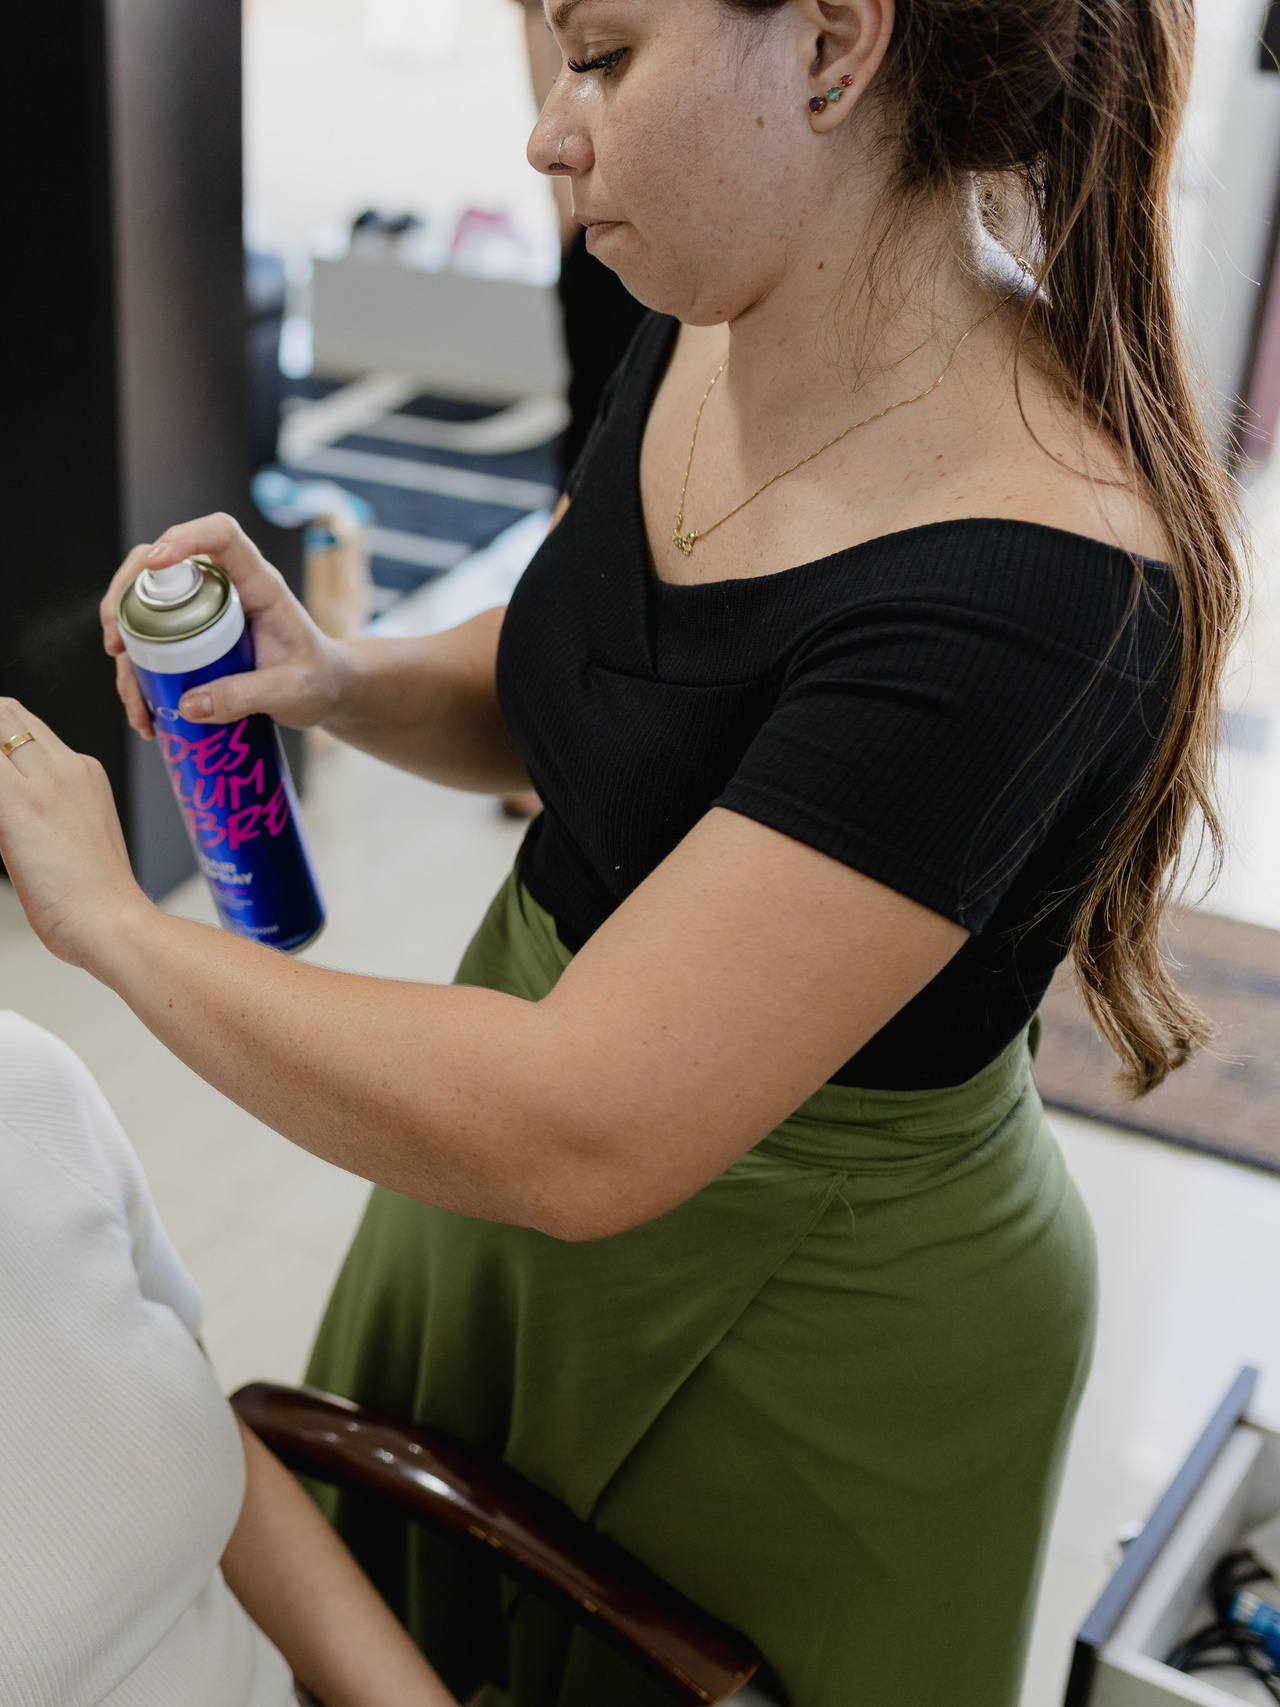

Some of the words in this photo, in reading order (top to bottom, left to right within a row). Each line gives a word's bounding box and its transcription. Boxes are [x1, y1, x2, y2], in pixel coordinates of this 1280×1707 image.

[158, 717, 250, 775] DES
[173, 758, 264, 810] LUM
[185, 779, 290, 851] BRE
